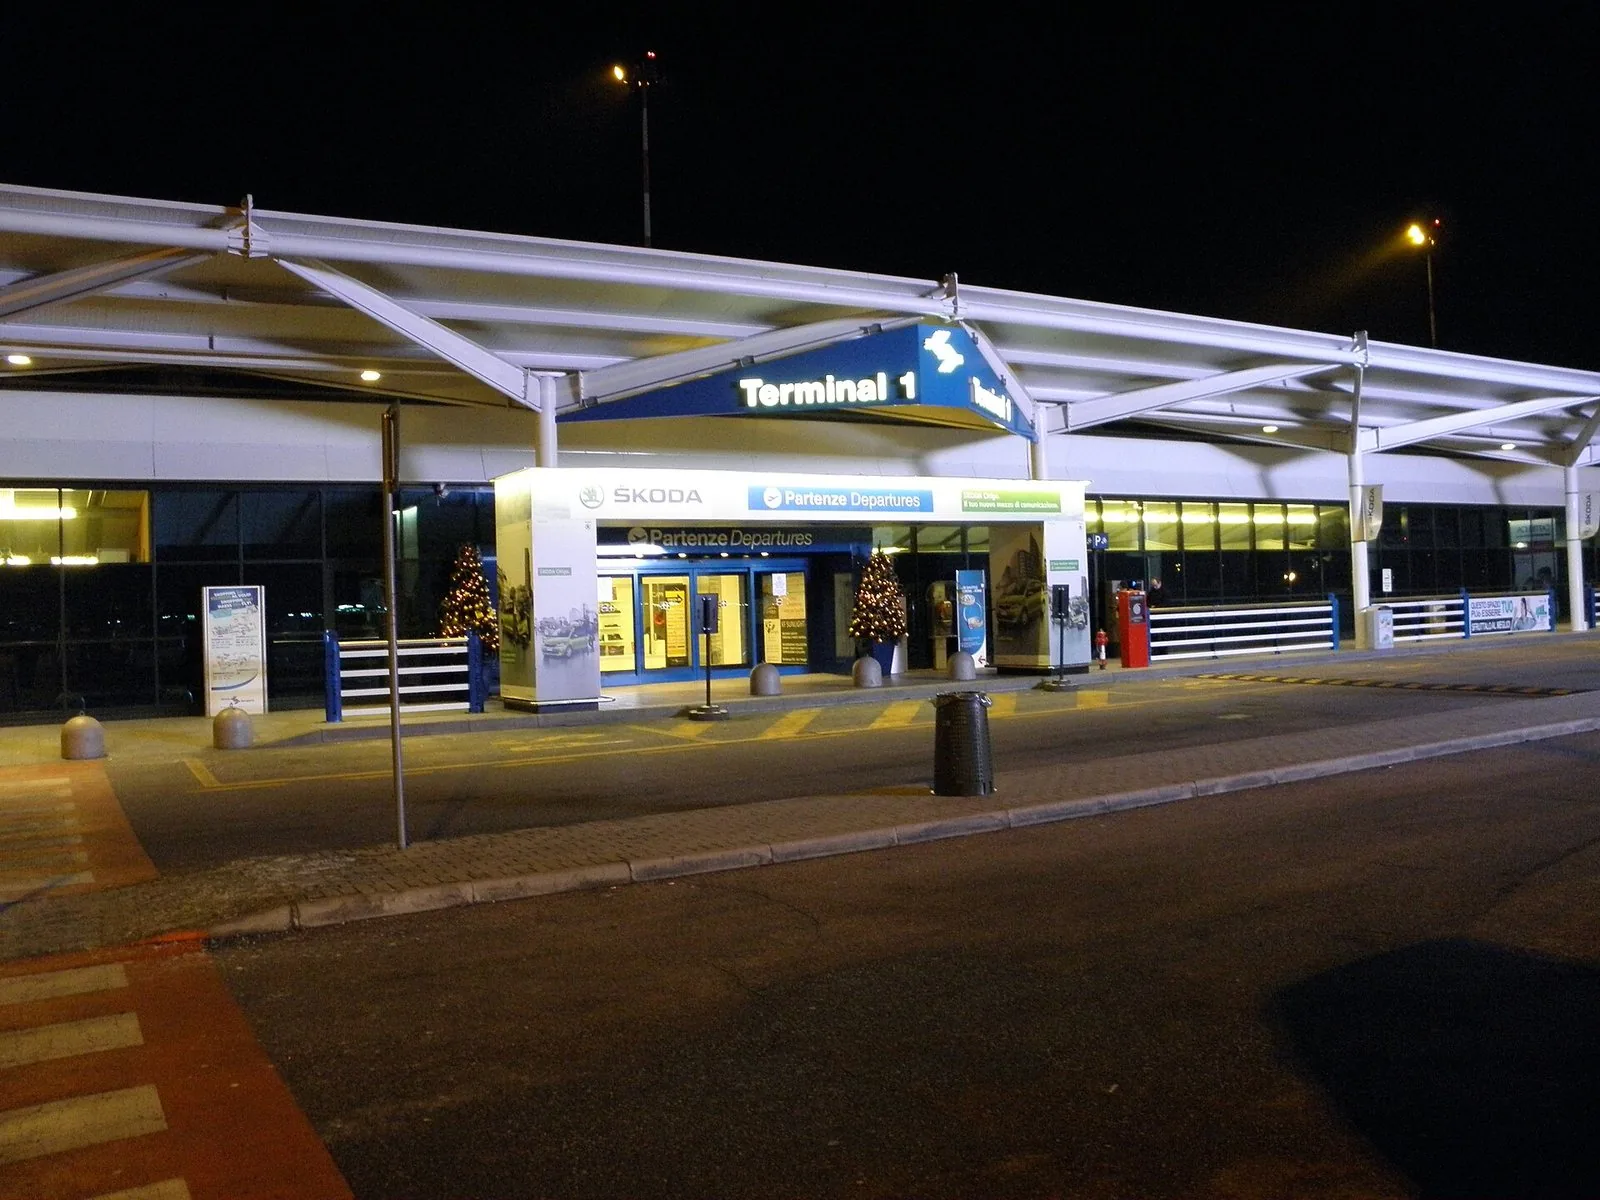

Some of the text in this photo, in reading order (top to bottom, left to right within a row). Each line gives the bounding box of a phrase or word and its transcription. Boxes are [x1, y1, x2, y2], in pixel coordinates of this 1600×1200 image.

[739, 371, 915, 407] Terminal 1
[614, 484, 703, 504] ŠKODA
[784, 490, 921, 510] Partenze Departures
[650, 529, 813, 550] Partenze Departures
[1095, 535, 1102, 547] P
[1481, 608, 1501, 617] ESSERE
[1501, 600, 1513, 614] TUO
